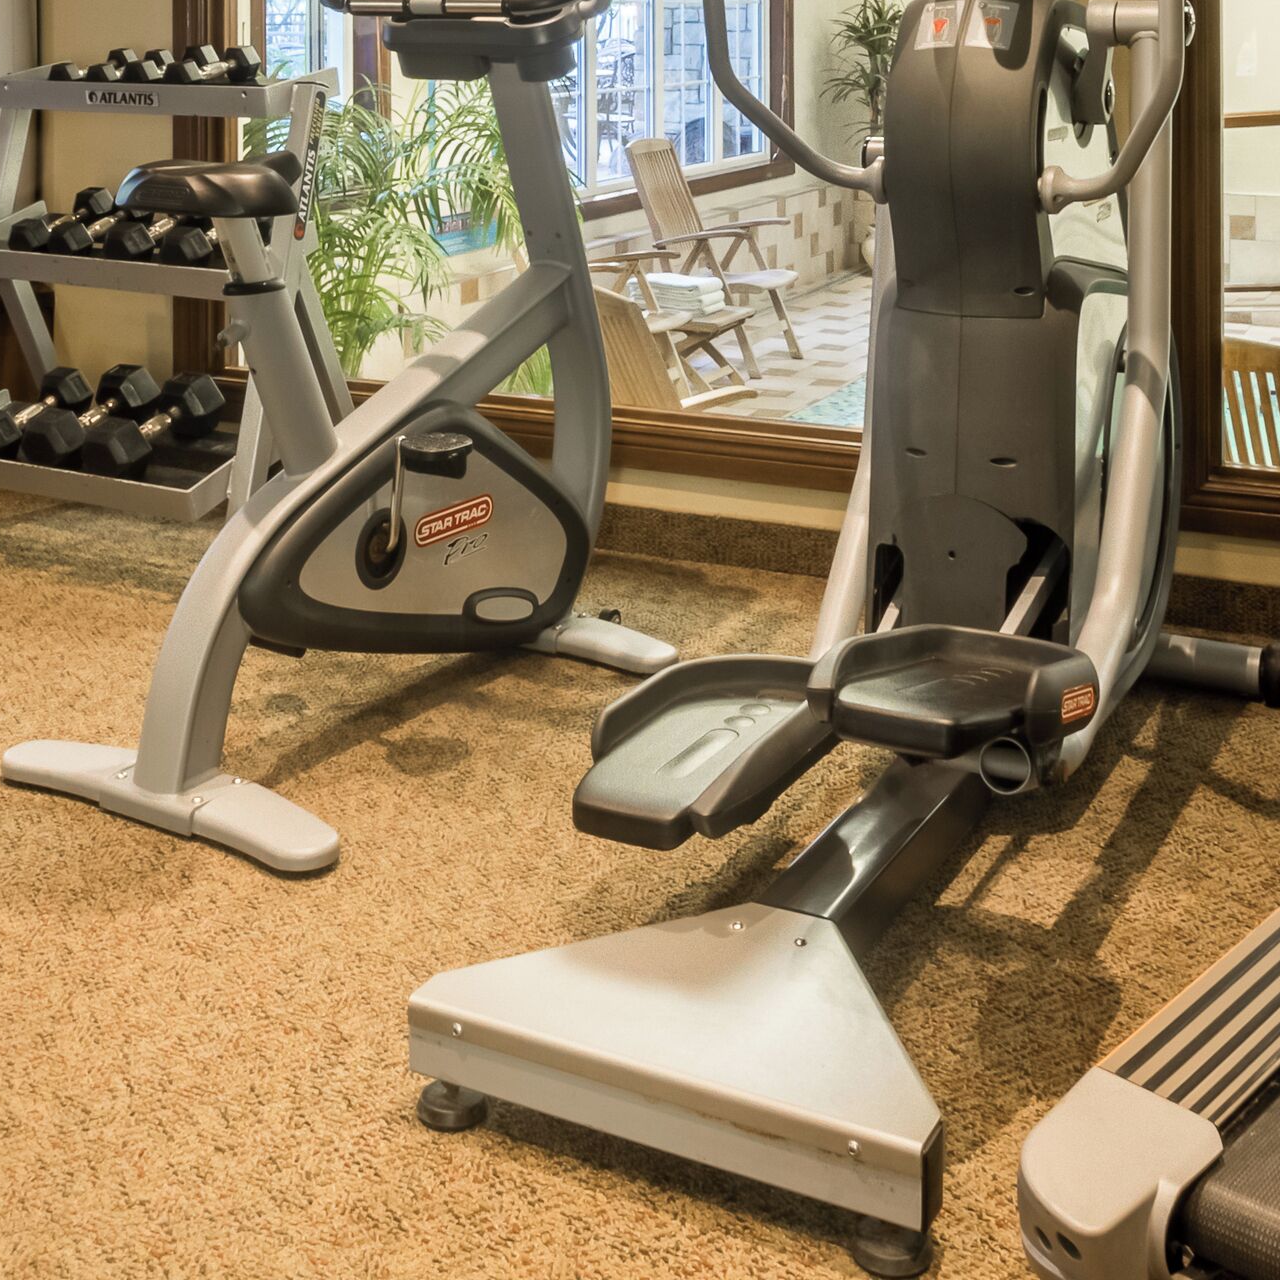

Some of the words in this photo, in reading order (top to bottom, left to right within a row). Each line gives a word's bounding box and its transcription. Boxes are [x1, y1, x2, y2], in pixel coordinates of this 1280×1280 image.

[99, 91, 154, 106] ATLANTIS
[298, 149, 316, 223] ATLANTIS
[418, 516, 453, 539] STAR
[454, 503, 489, 526] TRAC
[443, 533, 488, 567] Pro
